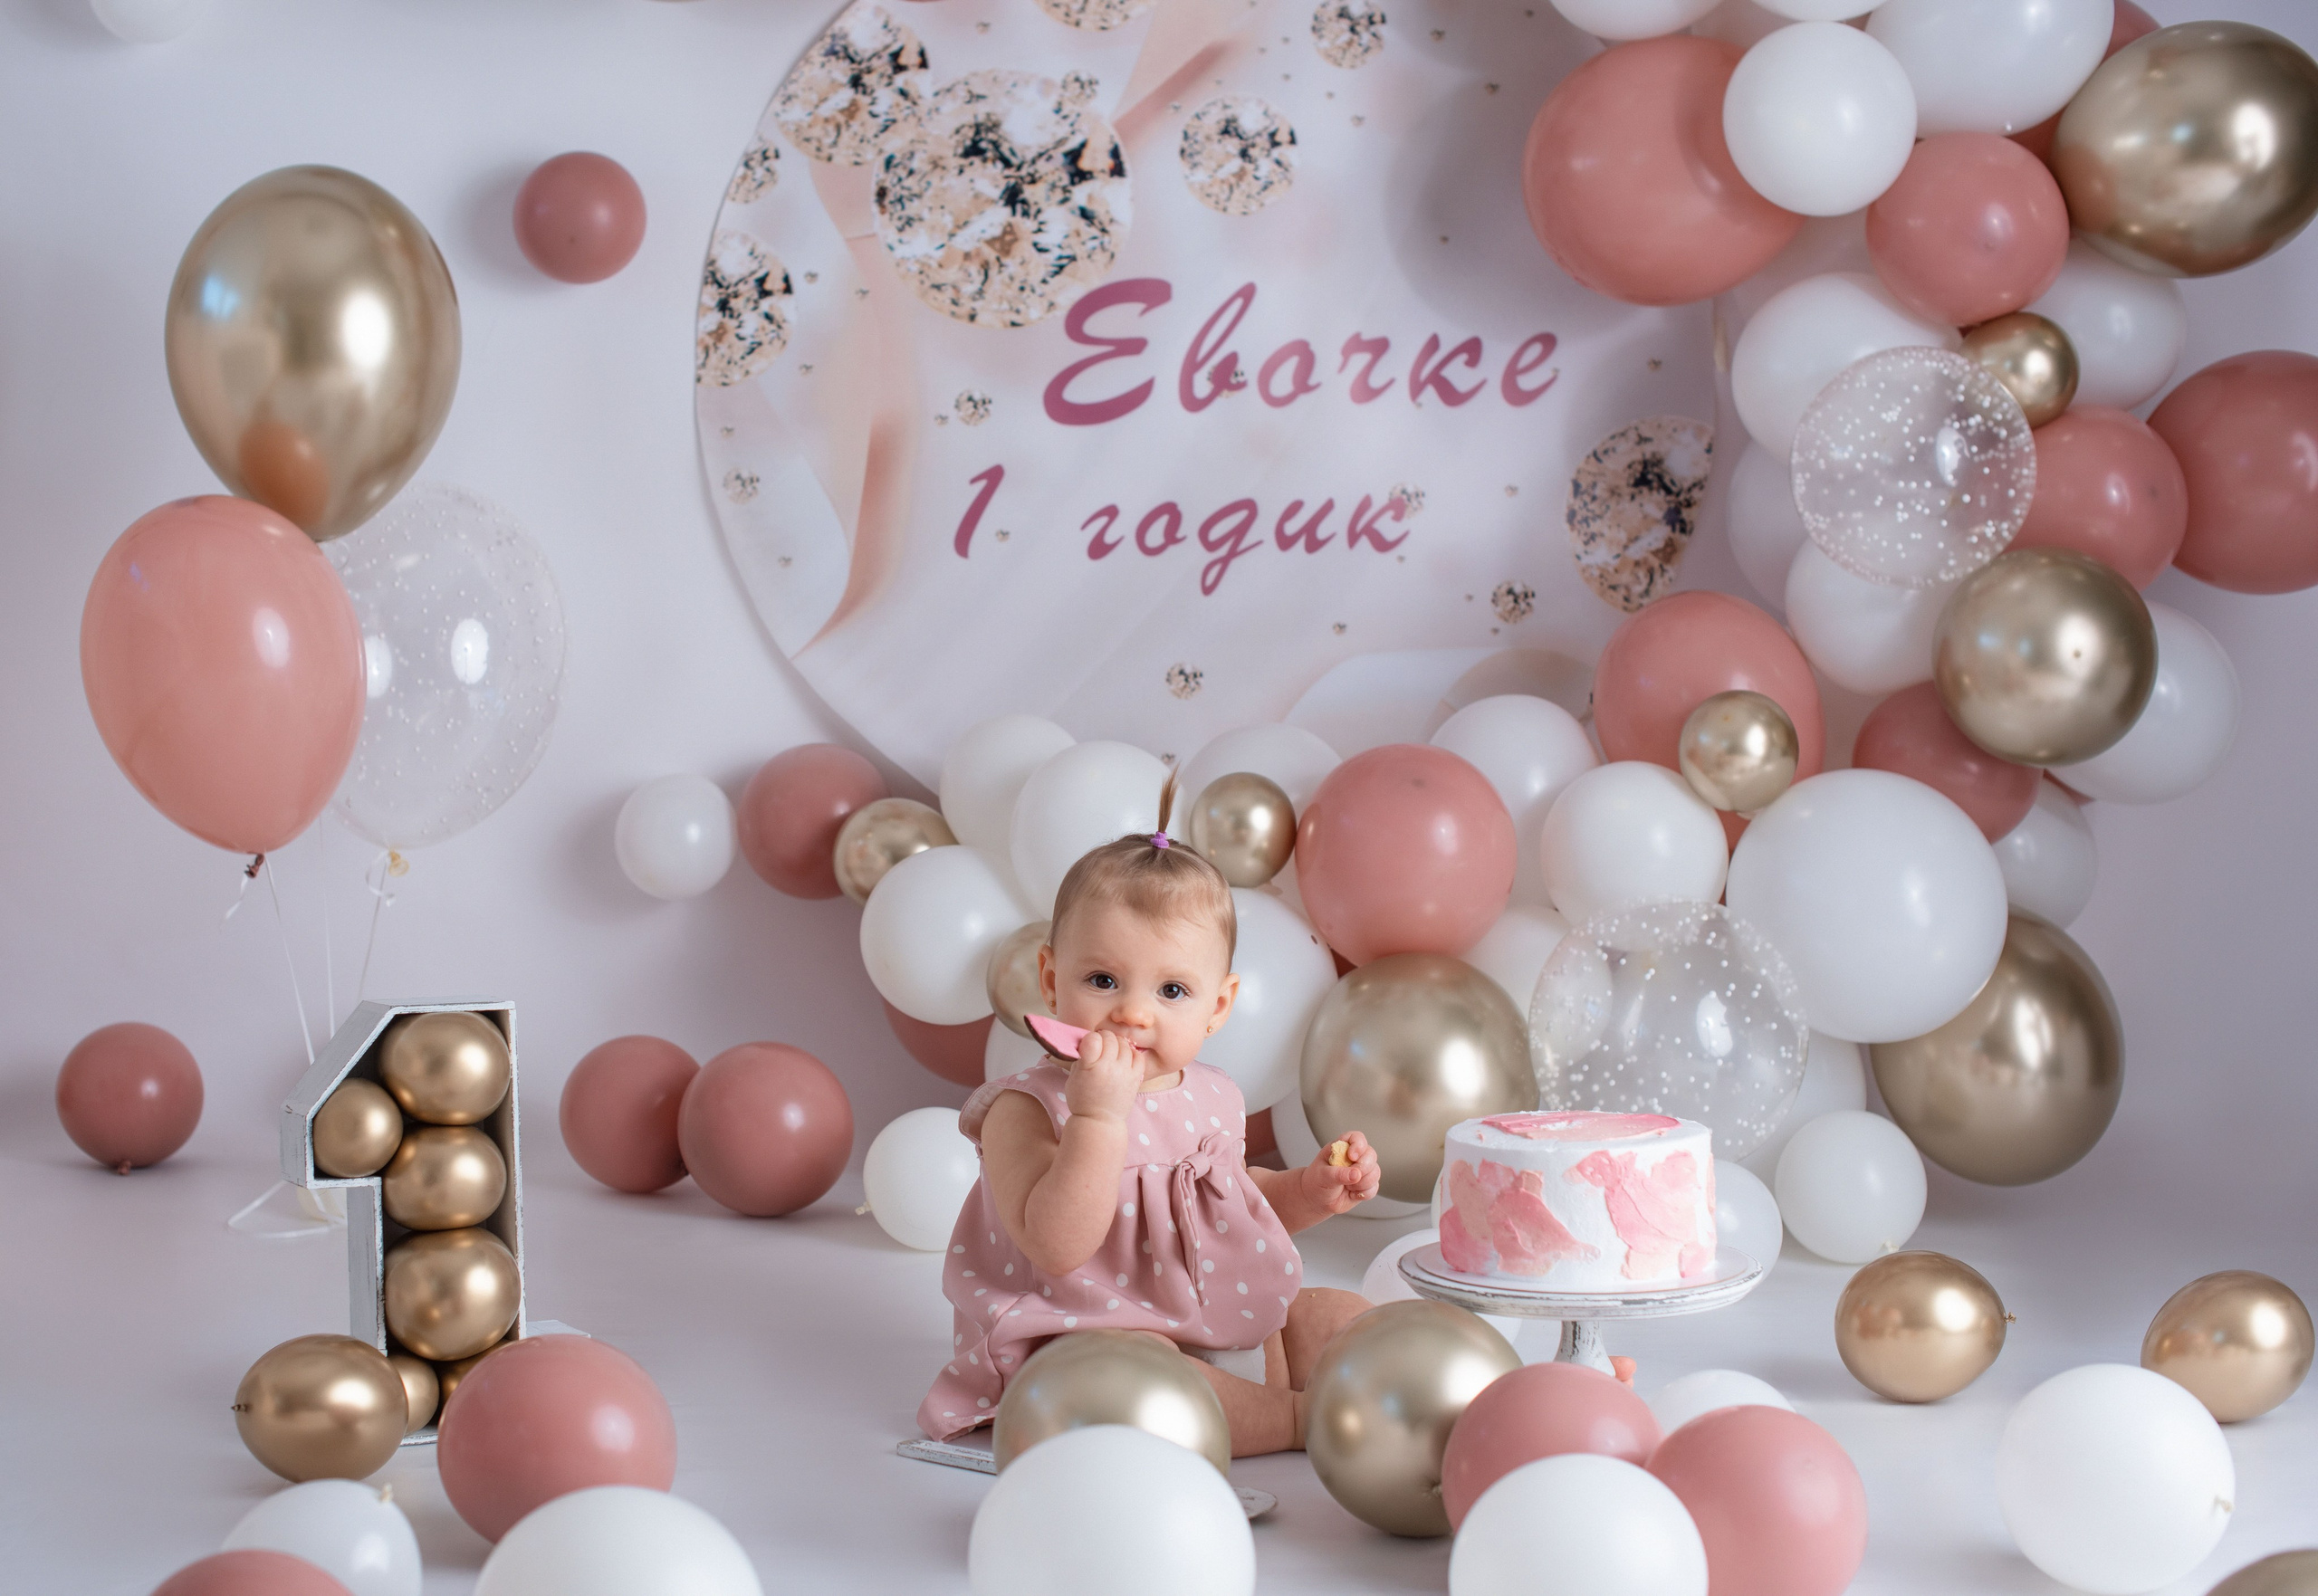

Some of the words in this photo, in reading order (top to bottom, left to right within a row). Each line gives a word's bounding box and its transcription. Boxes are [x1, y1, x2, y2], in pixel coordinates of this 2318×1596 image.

[1043, 278, 1559, 426] Евочке
[953, 464, 1006, 559] 1
[1080, 493, 1412, 597] годик
